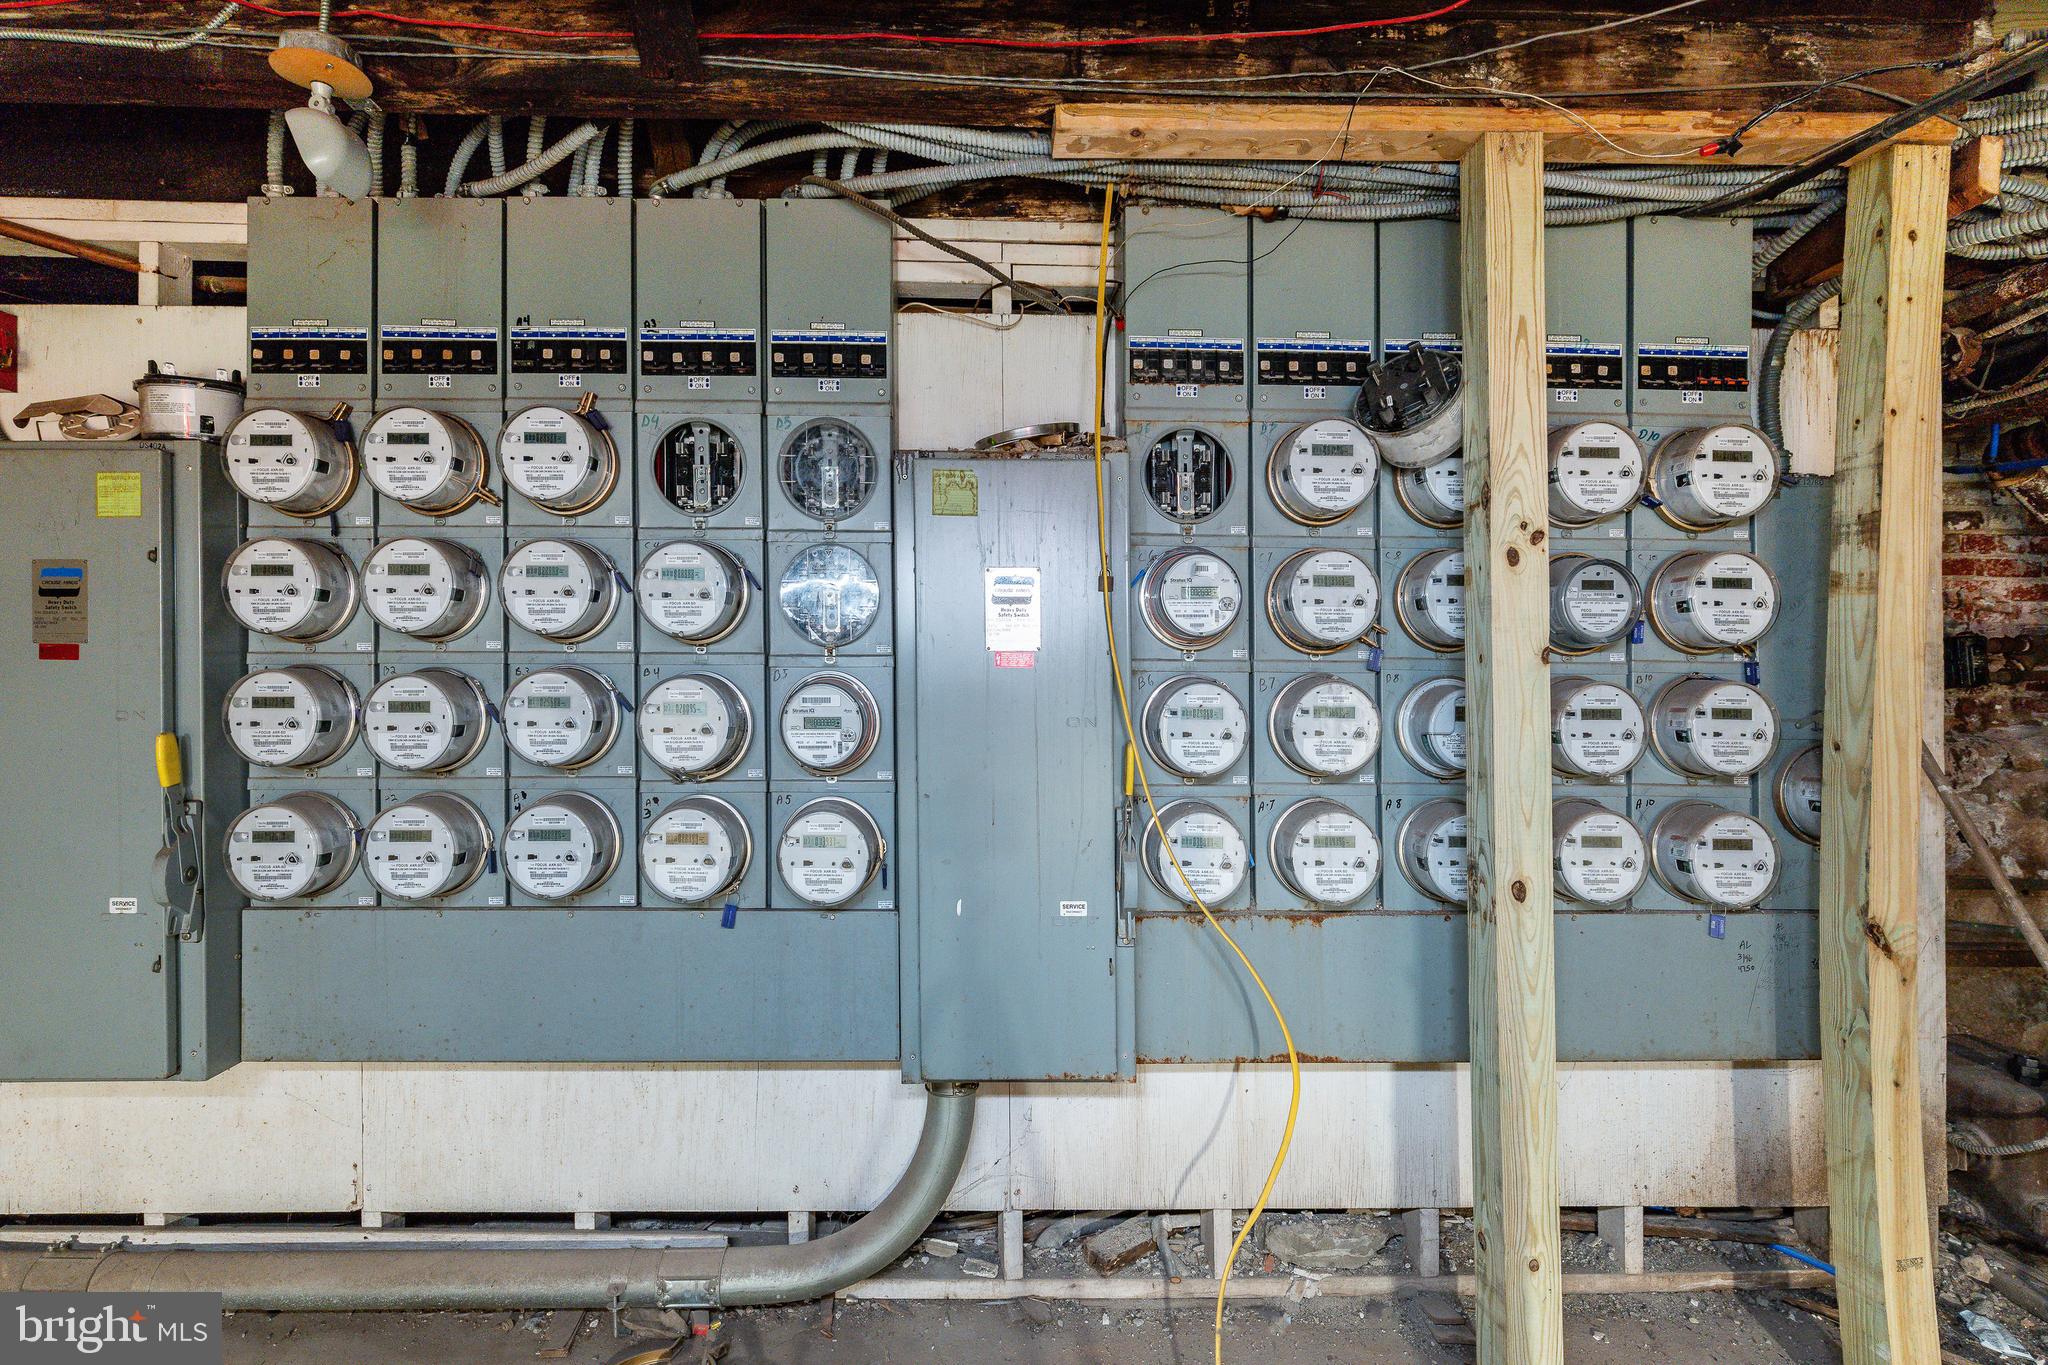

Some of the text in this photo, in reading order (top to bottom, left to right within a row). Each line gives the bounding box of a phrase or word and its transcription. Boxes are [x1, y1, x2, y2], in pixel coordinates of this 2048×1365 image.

[642, 414, 659, 429] D4
[776, 416, 791, 430] D5
[1638, 429, 1660, 441] D10
[643, 667, 660, 680] B4
[774, 669, 789, 681] B5
[1636, 674, 1652, 684] B10
[1138, 674, 1153, 690] B6
[1260, 677, 1275, 692] B7
[777, 795, 792, 805] A5
[1636, 799, 1655, 810] A10
[1740, 940, 1752, 949] AL
